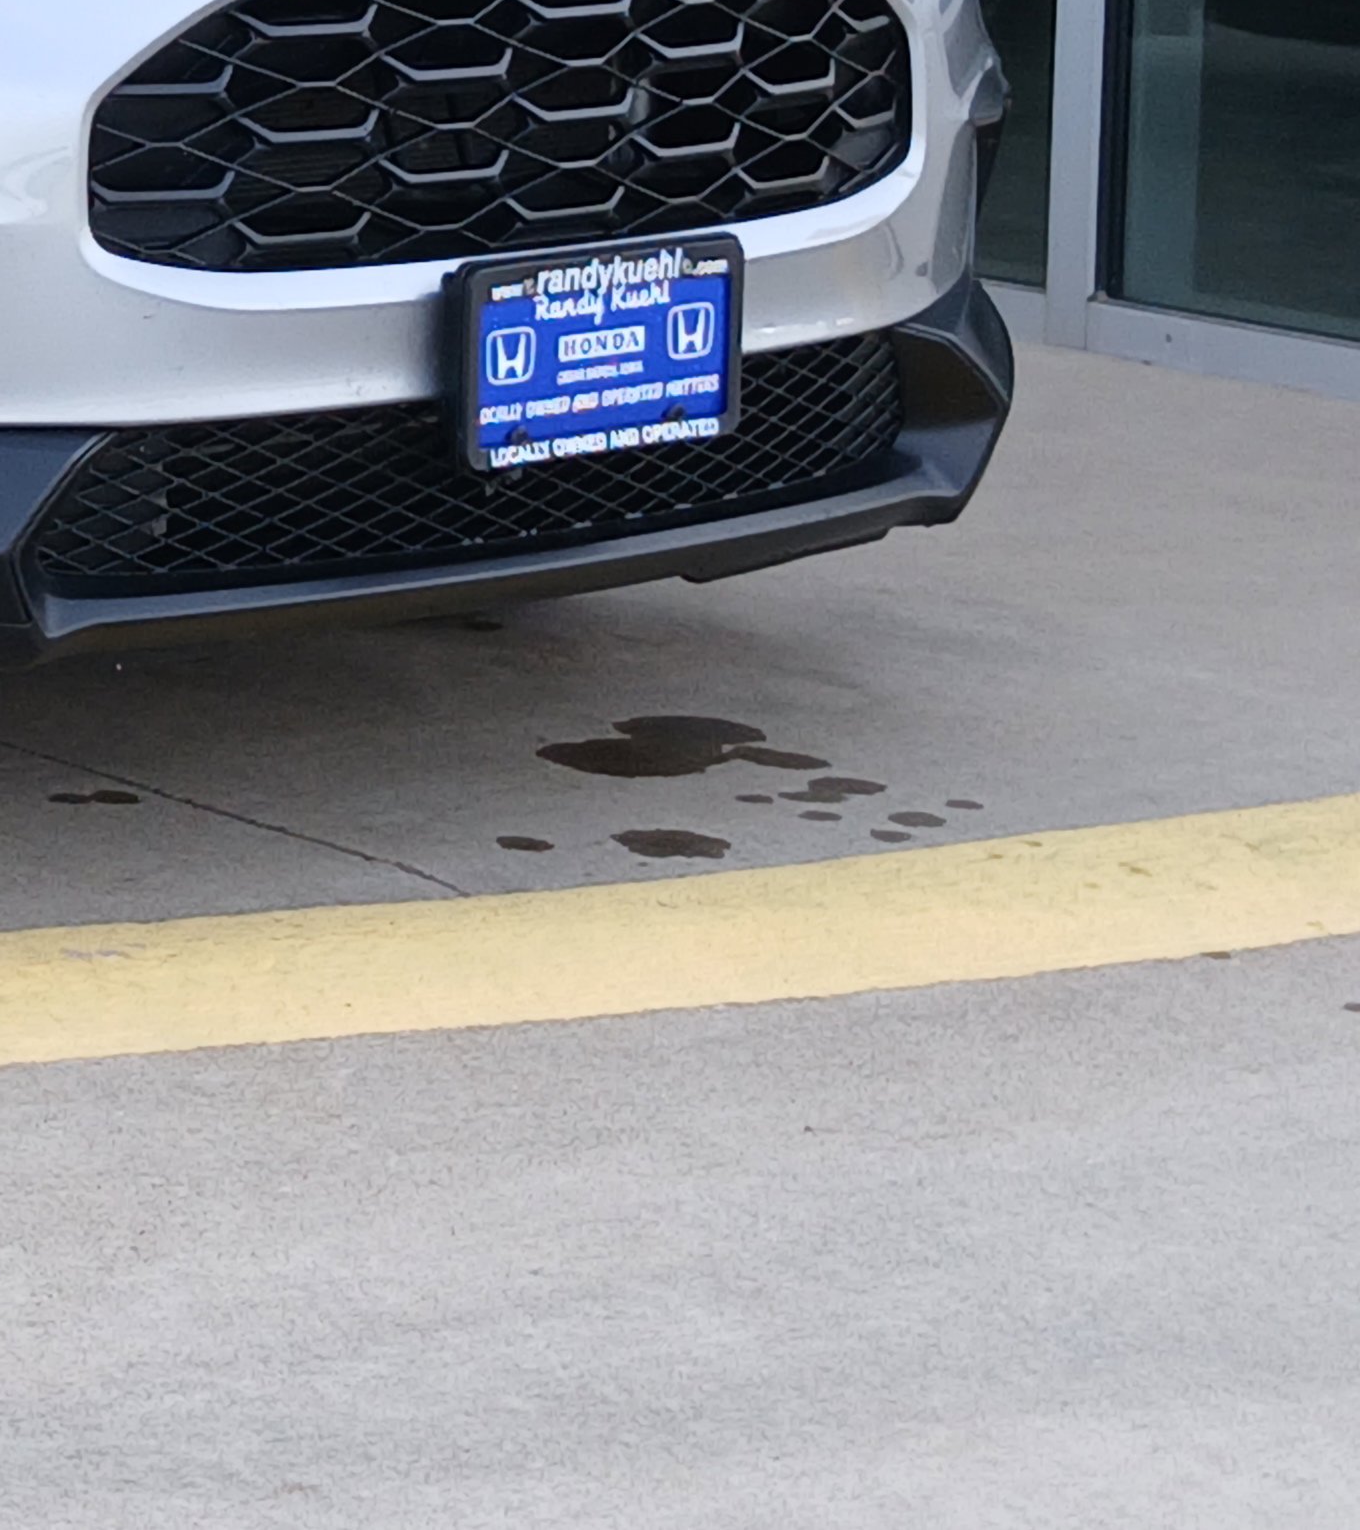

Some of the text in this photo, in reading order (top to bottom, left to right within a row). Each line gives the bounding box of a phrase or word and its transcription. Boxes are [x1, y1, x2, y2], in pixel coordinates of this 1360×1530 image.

[533, 281, 670, 324] Randy Kuehl
[563, 331, 639, 356] HONDA
[480, 403, 521, 425] OCALLY
[491, 441, 551, 467] LOCALLY
[611, 429, 640, 449] AND
[643, 418, 719, 444] OPERATED
